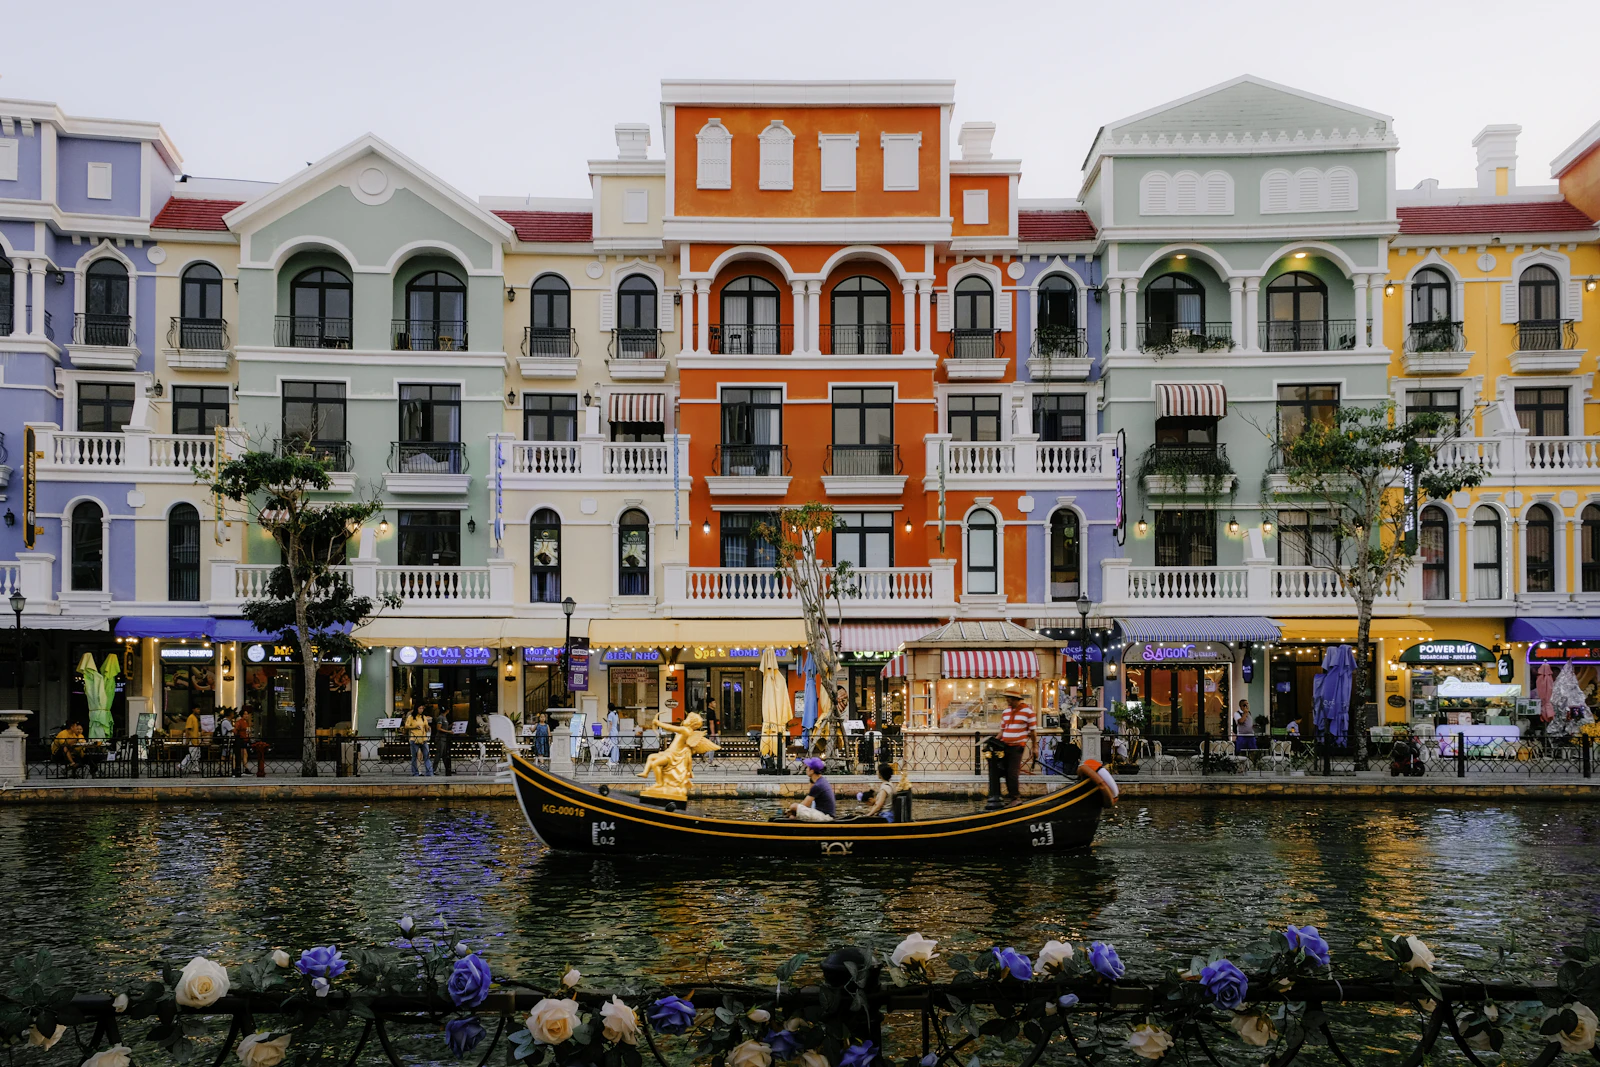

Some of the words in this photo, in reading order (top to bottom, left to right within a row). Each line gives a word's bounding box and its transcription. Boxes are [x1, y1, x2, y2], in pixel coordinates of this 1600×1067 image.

[421, 648, 461, 658] LOCAL
[465, 648, 490, 658] SPA
[694, 646, 716, 659] Spa
[729, 648, 759, 657] HOME
[1142, 644, 1196, 661] SAIGON
[1420, 645, 1455, 653] POWER
[542, 804, 585, 817] KG-00016
[600, 821, 615, 830] 0.4
[1030, 822, 1044, 832] 0.4
[600, 837, 615, 845] 0.2
[1032, 837, 1046, 846] 0.2
